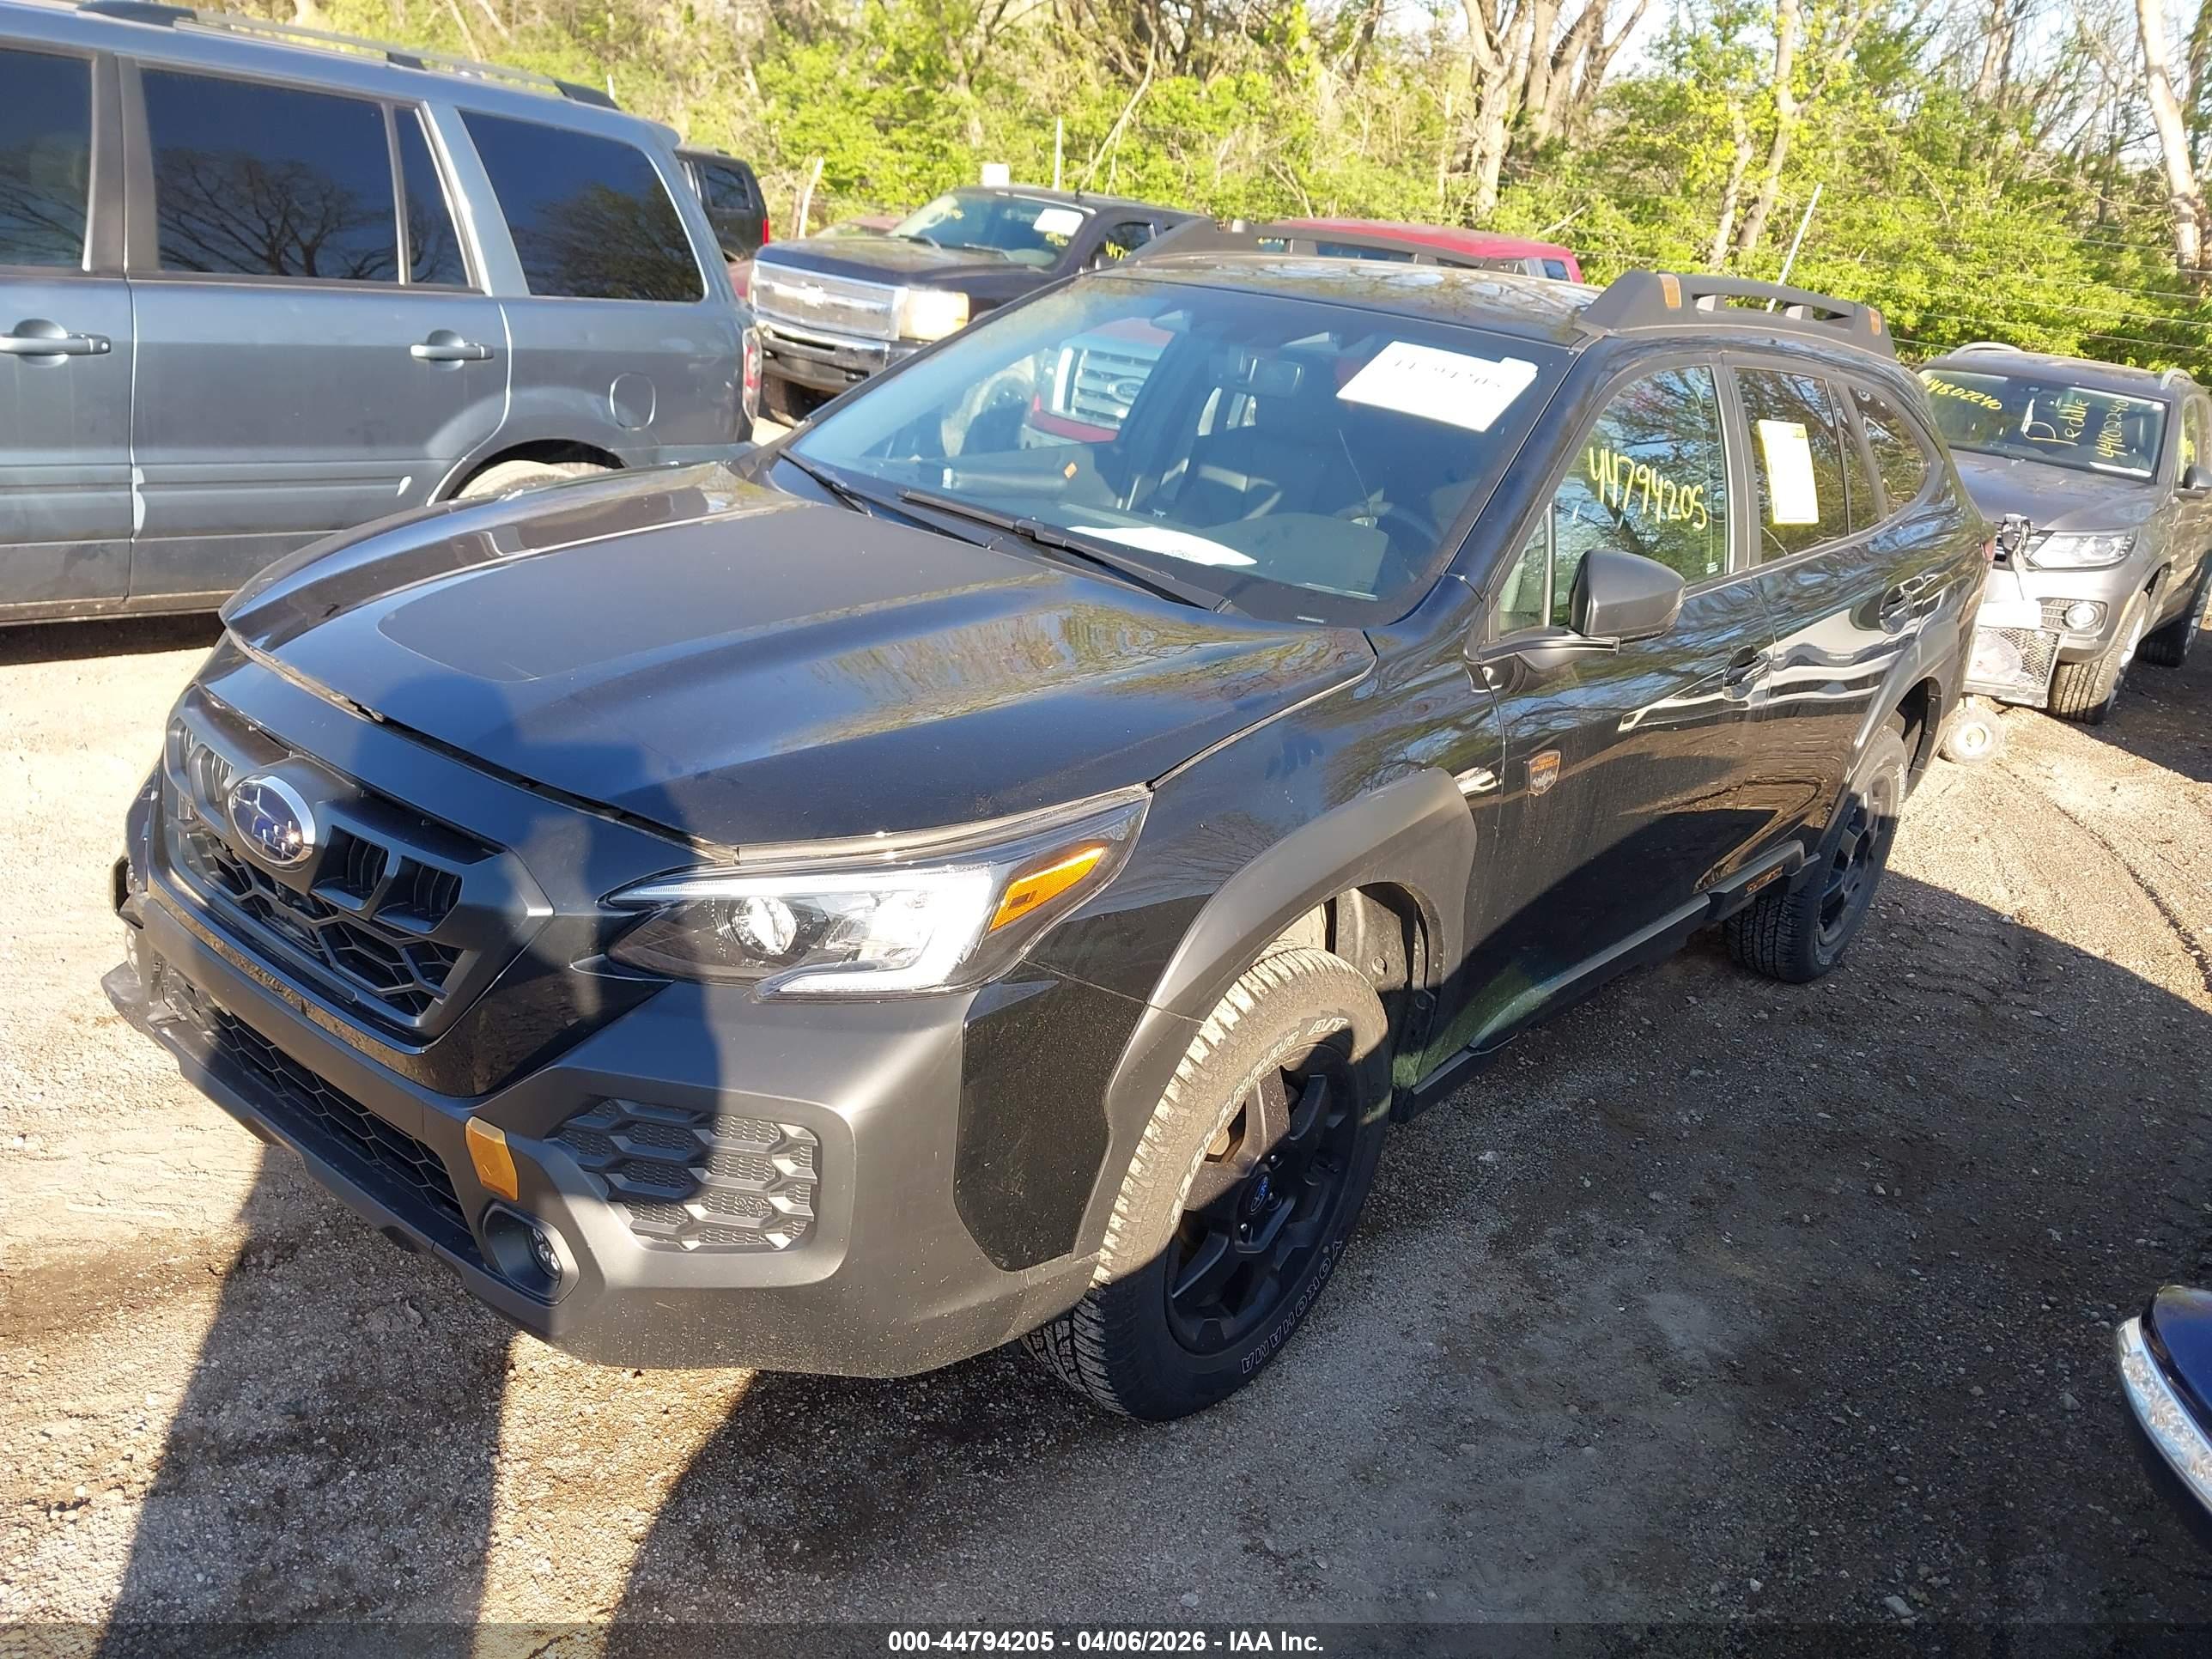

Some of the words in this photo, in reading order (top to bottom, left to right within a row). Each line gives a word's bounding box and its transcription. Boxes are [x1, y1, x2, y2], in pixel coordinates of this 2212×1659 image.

[2094, 399, 2130, 458] 44802240
[1589, 447, 1708, 530] 44794205
[1307, 1018, 1349, 1036] A/T
[1242, 1240, 1343, 1374] YOKOHAMA
